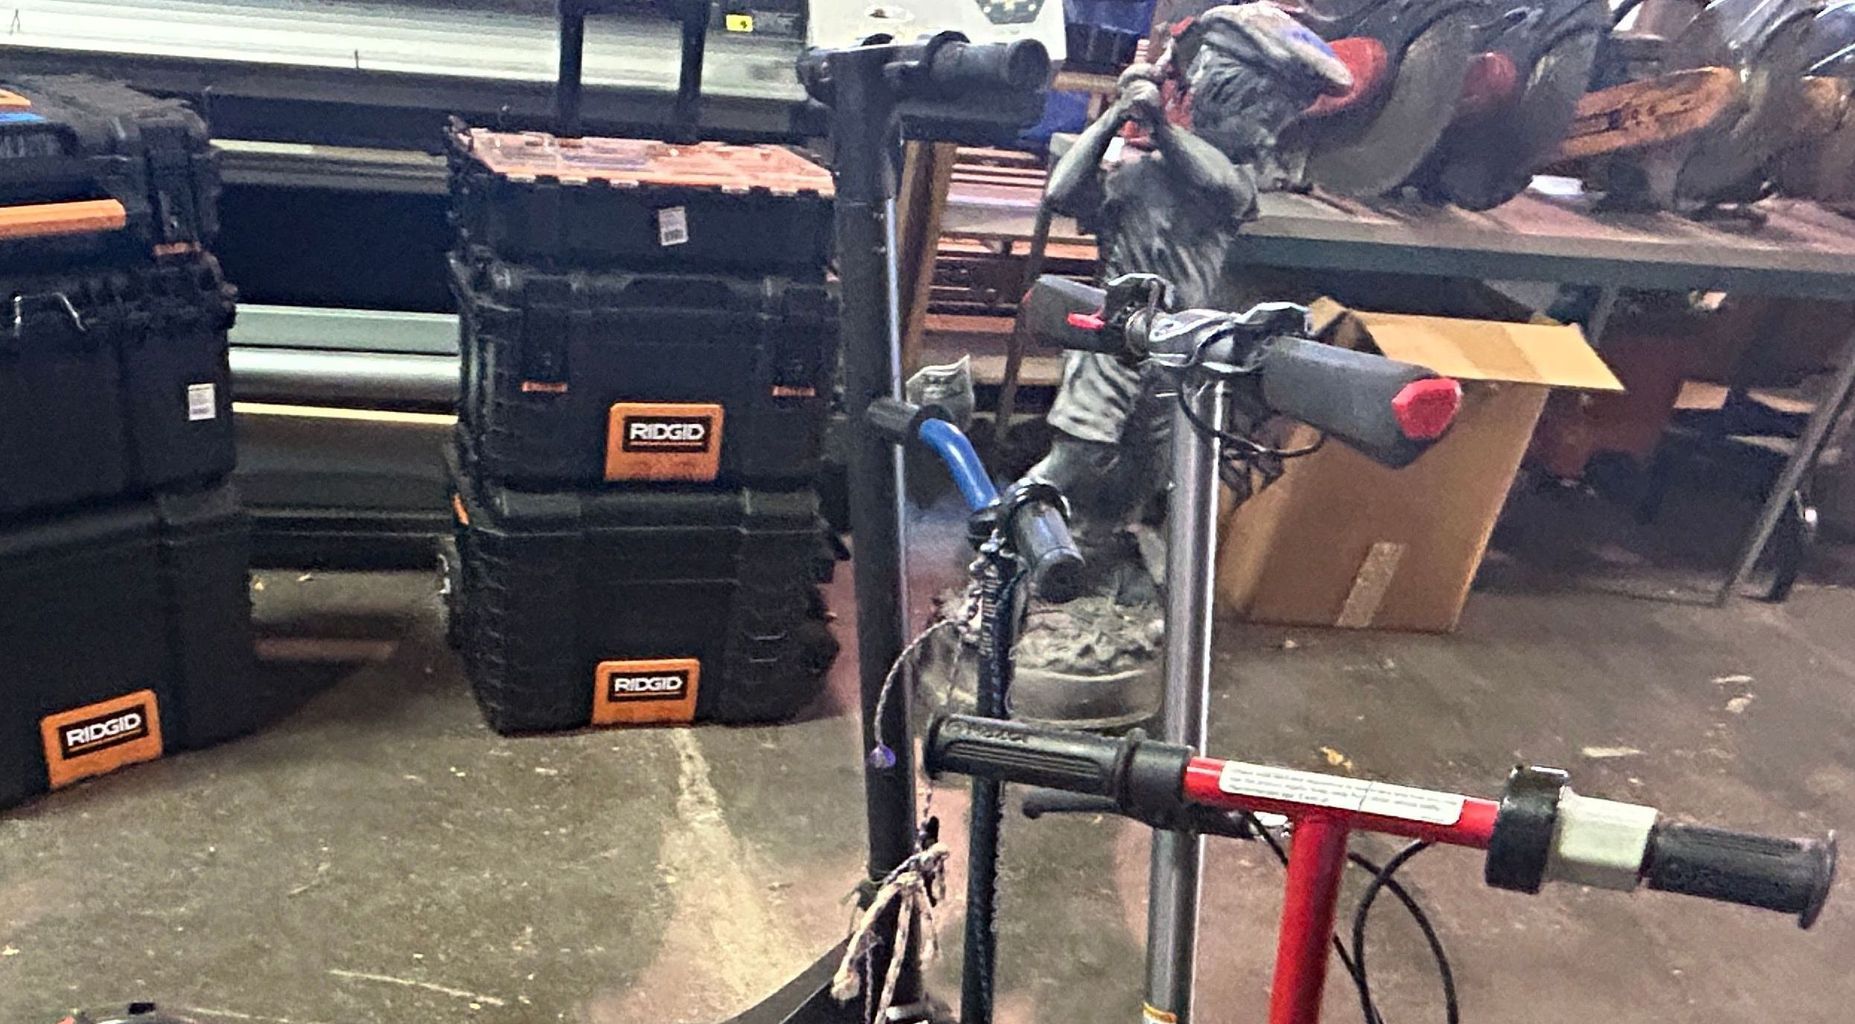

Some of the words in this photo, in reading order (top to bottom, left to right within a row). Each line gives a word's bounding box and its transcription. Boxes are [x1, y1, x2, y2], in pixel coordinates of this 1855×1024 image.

[630, 422, 705, 440] RIDGID
[614, 676, 683, 692] RIDGID
[65, 712, 142, 747] RIDGID
